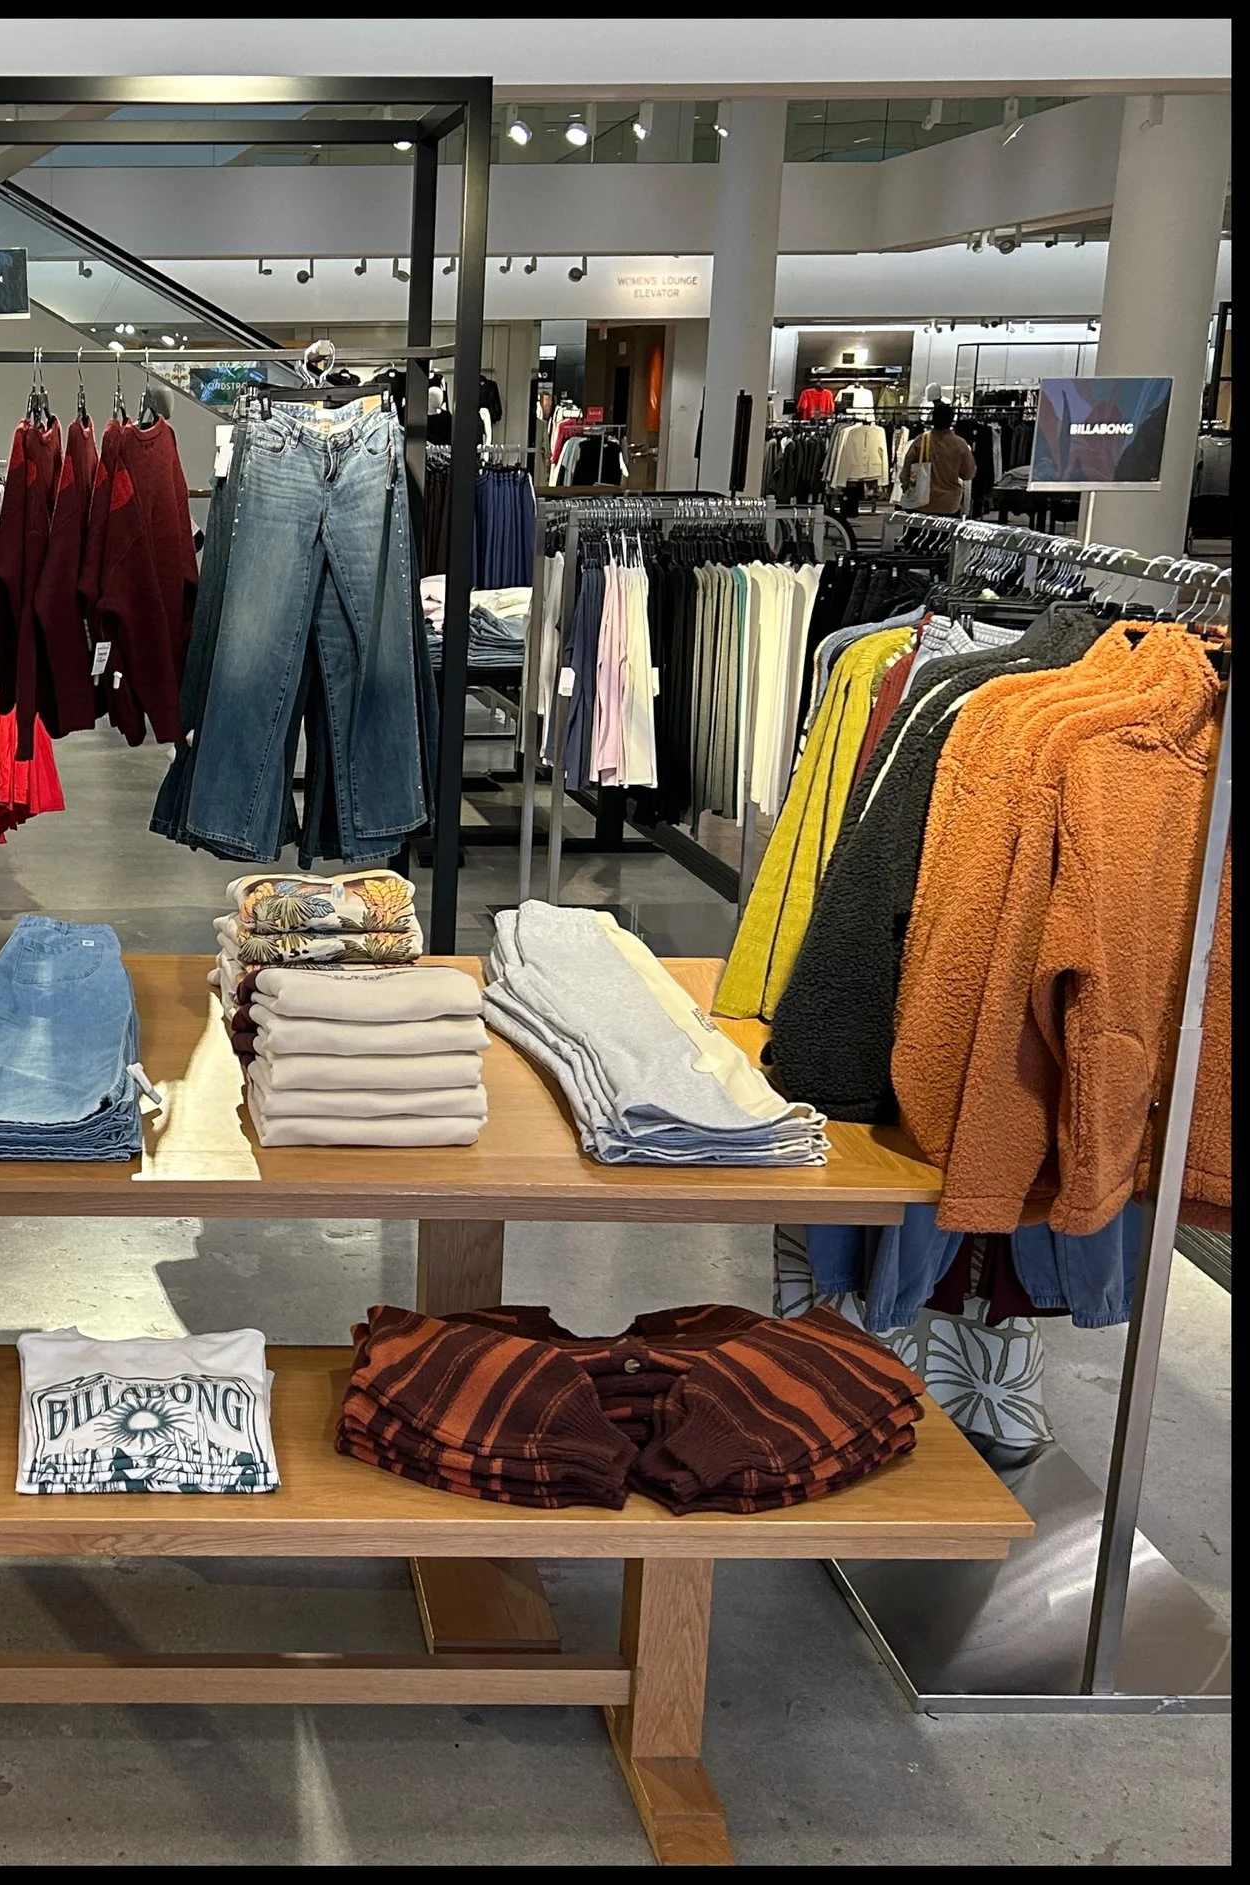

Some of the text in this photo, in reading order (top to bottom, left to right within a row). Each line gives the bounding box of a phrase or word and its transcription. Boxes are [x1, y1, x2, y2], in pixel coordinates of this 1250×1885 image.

[617, 276, 698, 285] WOMEN'S LOUNGE
[634, 289, 680, 298] ELEVATOR
[1070, 423, 1134, 434] BILLABONG
[47, 1383, 243, 1440] BILLABONG
